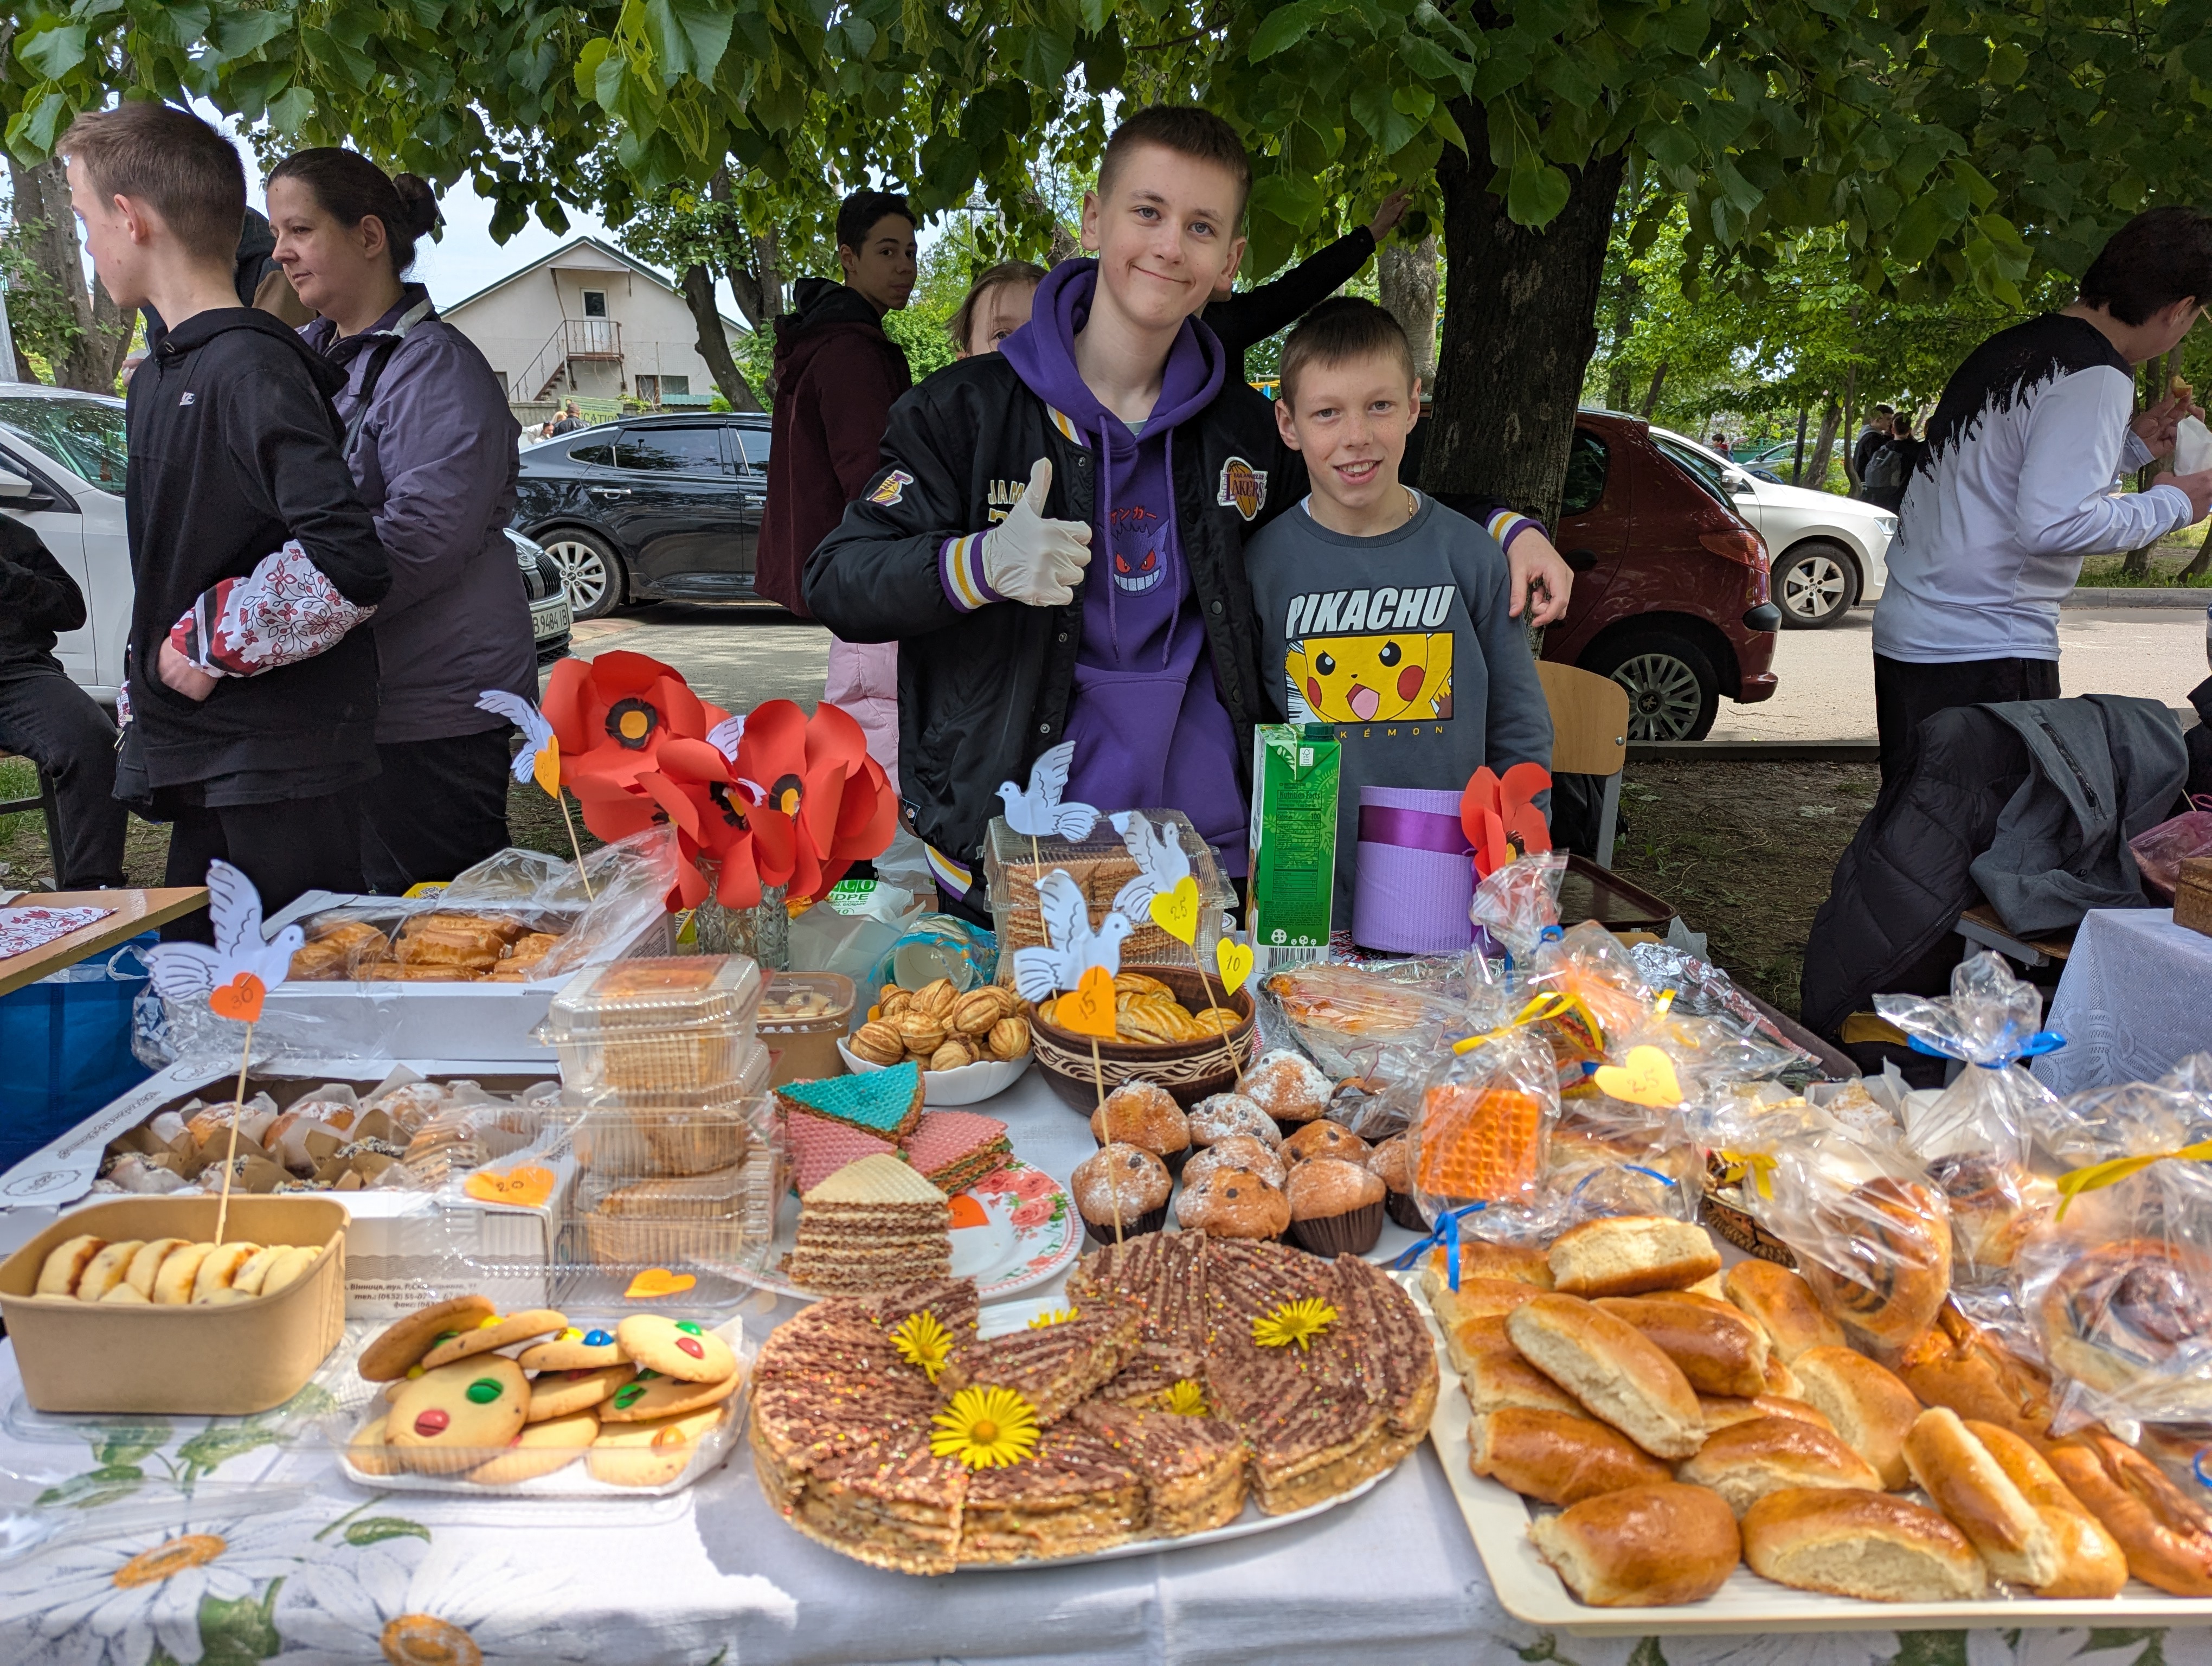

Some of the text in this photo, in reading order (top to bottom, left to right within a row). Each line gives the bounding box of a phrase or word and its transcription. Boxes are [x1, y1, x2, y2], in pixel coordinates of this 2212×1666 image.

[988, 480, 1025, 505] JAM
[1222, 473, 1264, 506] LAKERS
[541, 611, 559, 633] 9484
[1286, 586, 1455, 639] PIKACHU
[1340, 726, 1443, 739] KÉMON
[1306, 791, 1320, 799] Facts
[1171, 896, 1187, 921] 25
[1226, 956, 1240, 971] 10
[231, 988, 253, 1009] 30
[1078, 990, 1096, 1020] 15
[1627, 1067, 1658, 1093] 25
